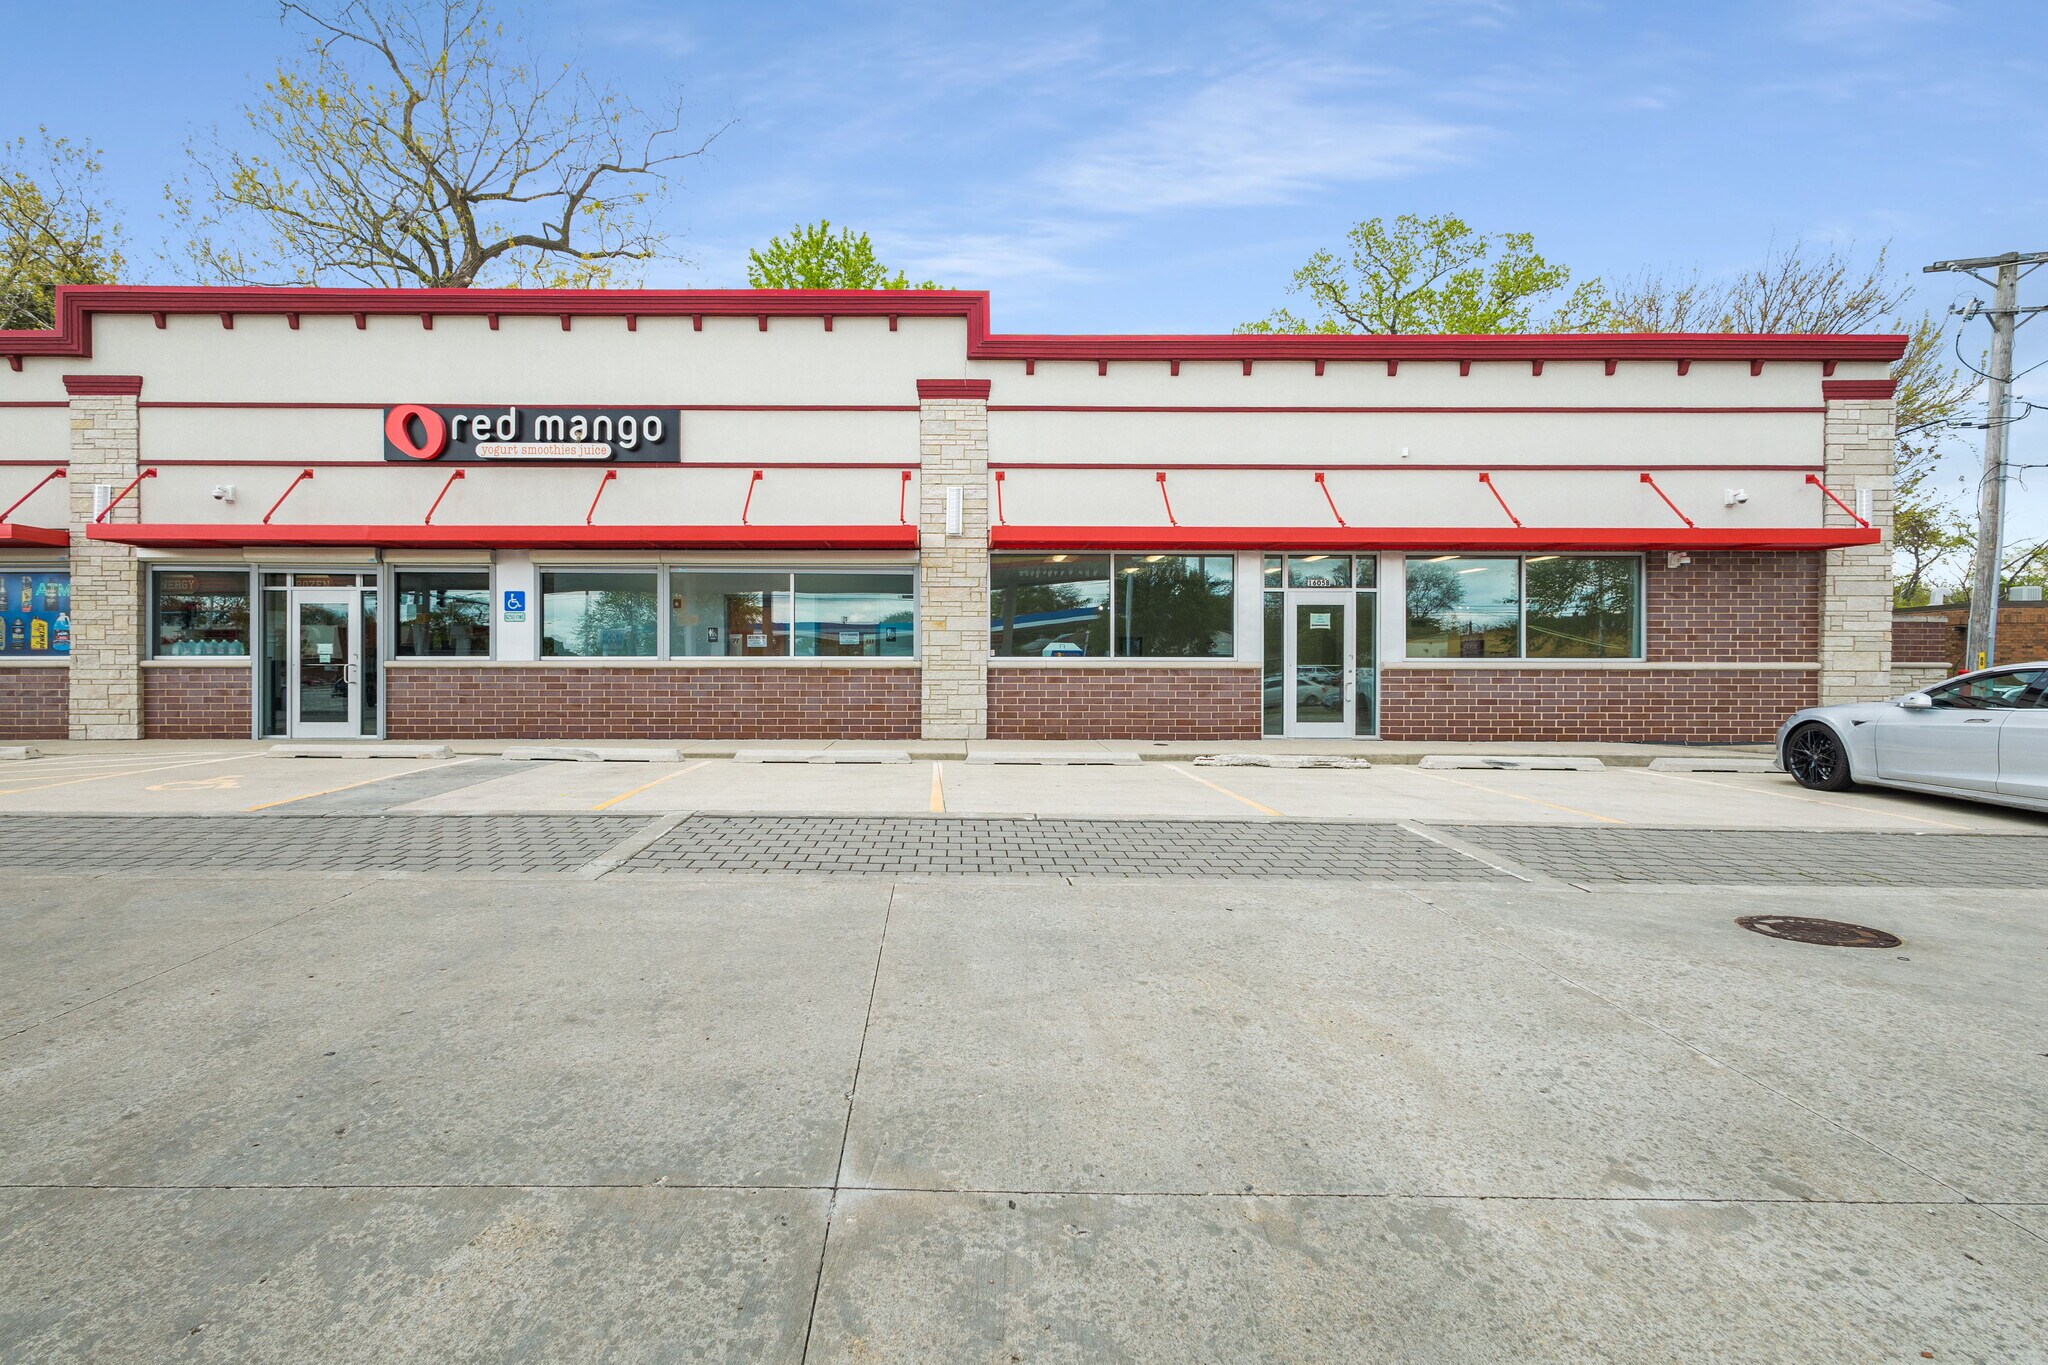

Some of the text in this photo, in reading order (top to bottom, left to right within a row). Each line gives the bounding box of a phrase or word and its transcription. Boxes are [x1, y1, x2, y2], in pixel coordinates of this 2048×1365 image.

[452, 407, 662, 448] red mango
[481, 445, 607, 457] yogurt smoothies juice
[35, 583, 70, 596] ATM
